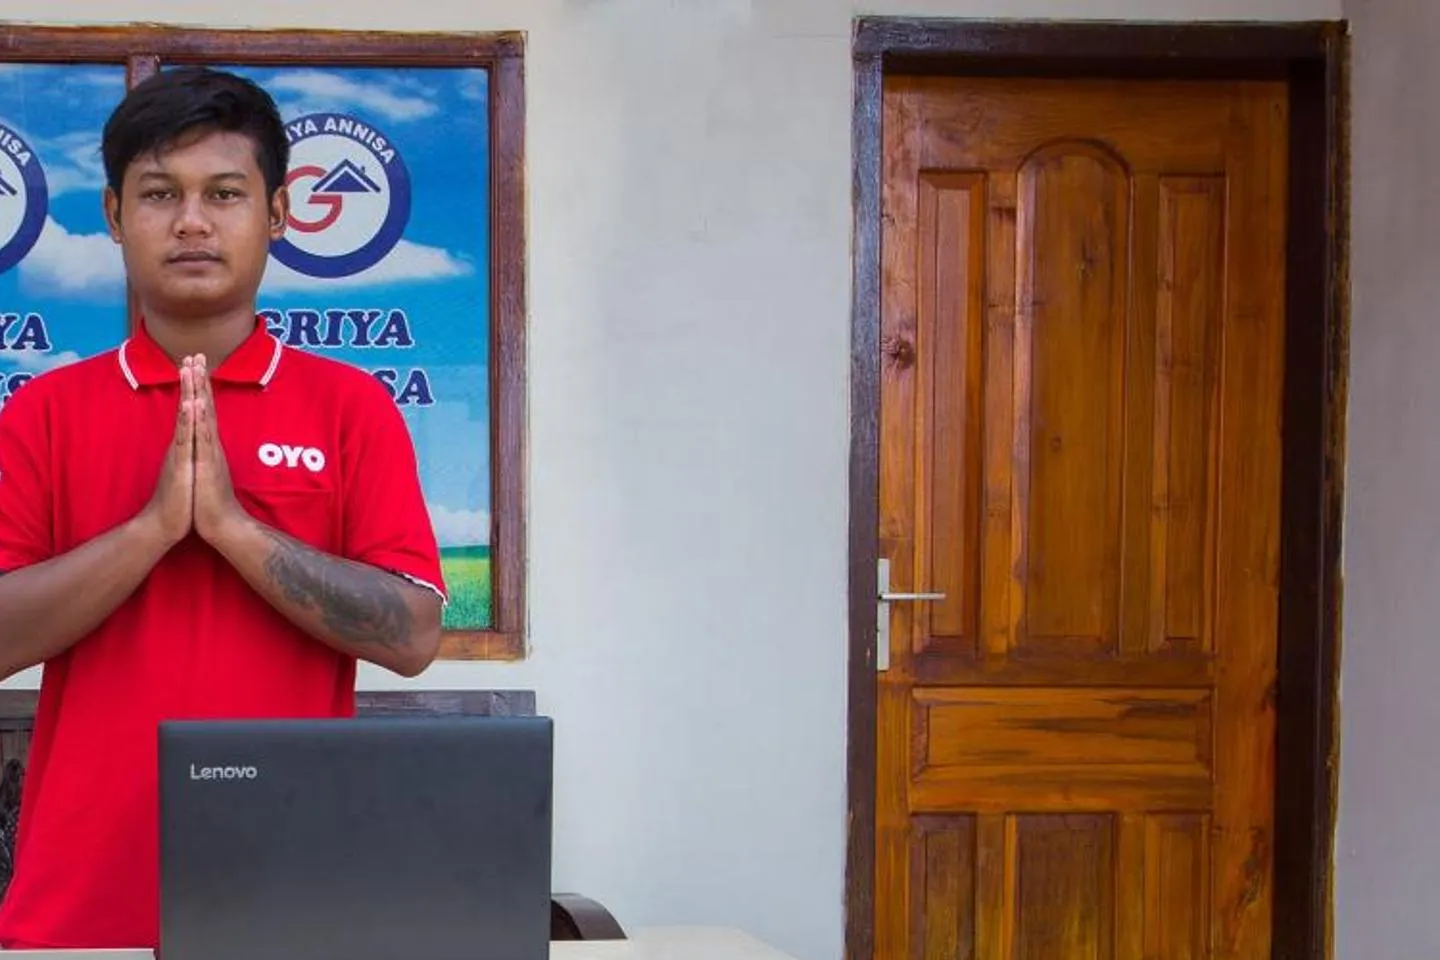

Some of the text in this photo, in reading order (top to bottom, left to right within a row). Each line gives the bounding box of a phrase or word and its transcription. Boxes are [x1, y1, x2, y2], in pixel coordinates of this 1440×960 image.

[285, 117, 396, 164] IYA ANNISA
[258, 442, 326, 472] OYO
[190, 763, 258, 780] Lenovo
